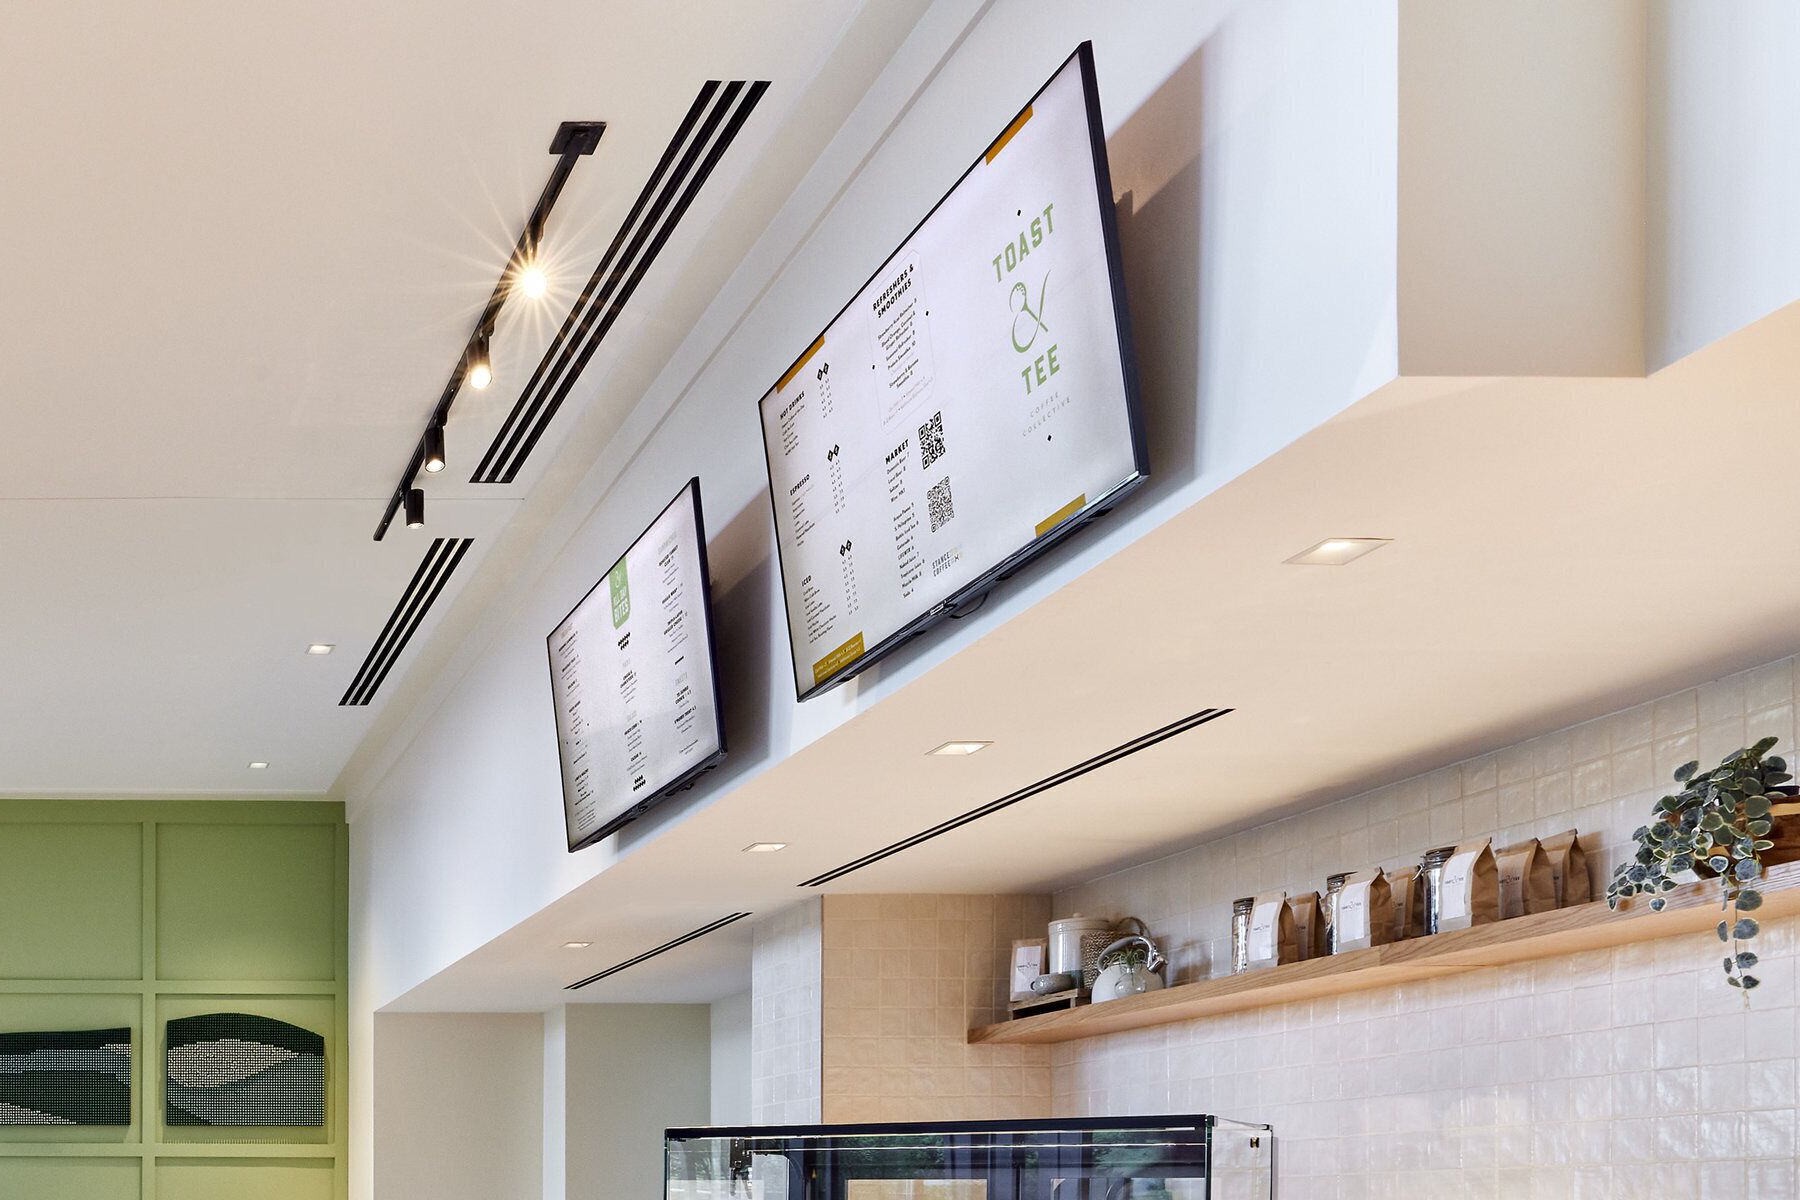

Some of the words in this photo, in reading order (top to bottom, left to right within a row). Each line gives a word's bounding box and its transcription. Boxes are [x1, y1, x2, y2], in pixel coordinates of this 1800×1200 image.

[992, 203, 1054, 283] TOAST
[872, 269, 908, 311] REFRESHERS
[877, 278, 911, 318] SMOOTHIES
[1009, 270, 1051, 353] &
[1021, 344, 1060, 395] TEE
[1023, 397, 1070, 437] COLLECTIVE
[1031, 392, 1058, 418] COFFEE
[885, 439, 908, 465] MARKET
[790, 474, 809, 496] ESPRESSO
[932, 552, 949, 569] STANCE
[933, 560, 950, 577] COFFEE
[801, 575, 811, 587] ICED
